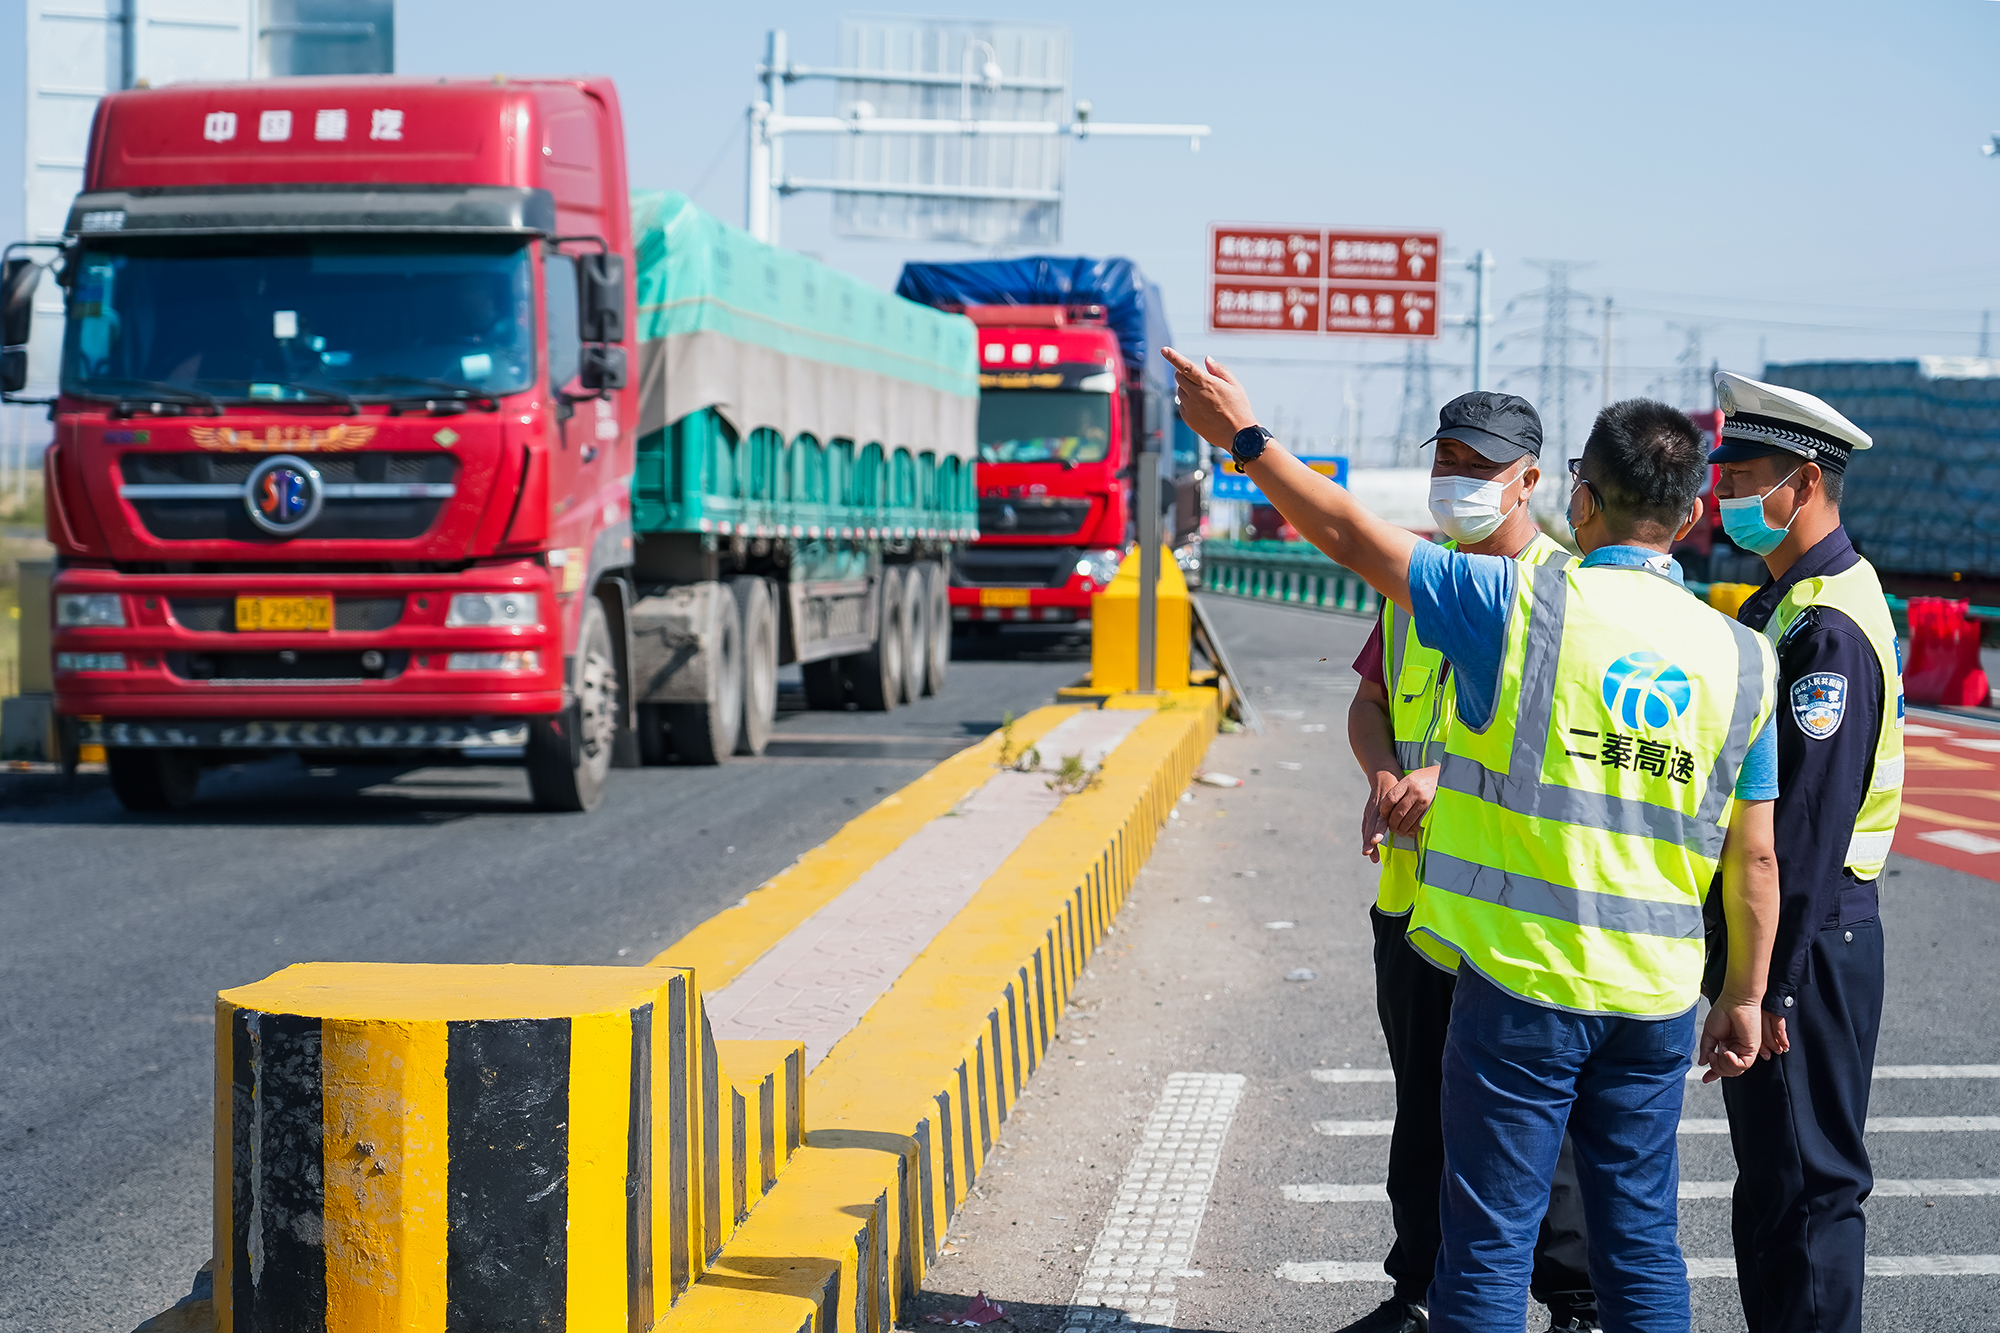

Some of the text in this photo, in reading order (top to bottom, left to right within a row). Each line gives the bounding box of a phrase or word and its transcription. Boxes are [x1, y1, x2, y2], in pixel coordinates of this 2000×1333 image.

[204, 108, 405, 143] 中国重汽
[1794, 676, 1843, 695] 中华人民共和国
[1565, 728, 1696, 785] 二秦高速
